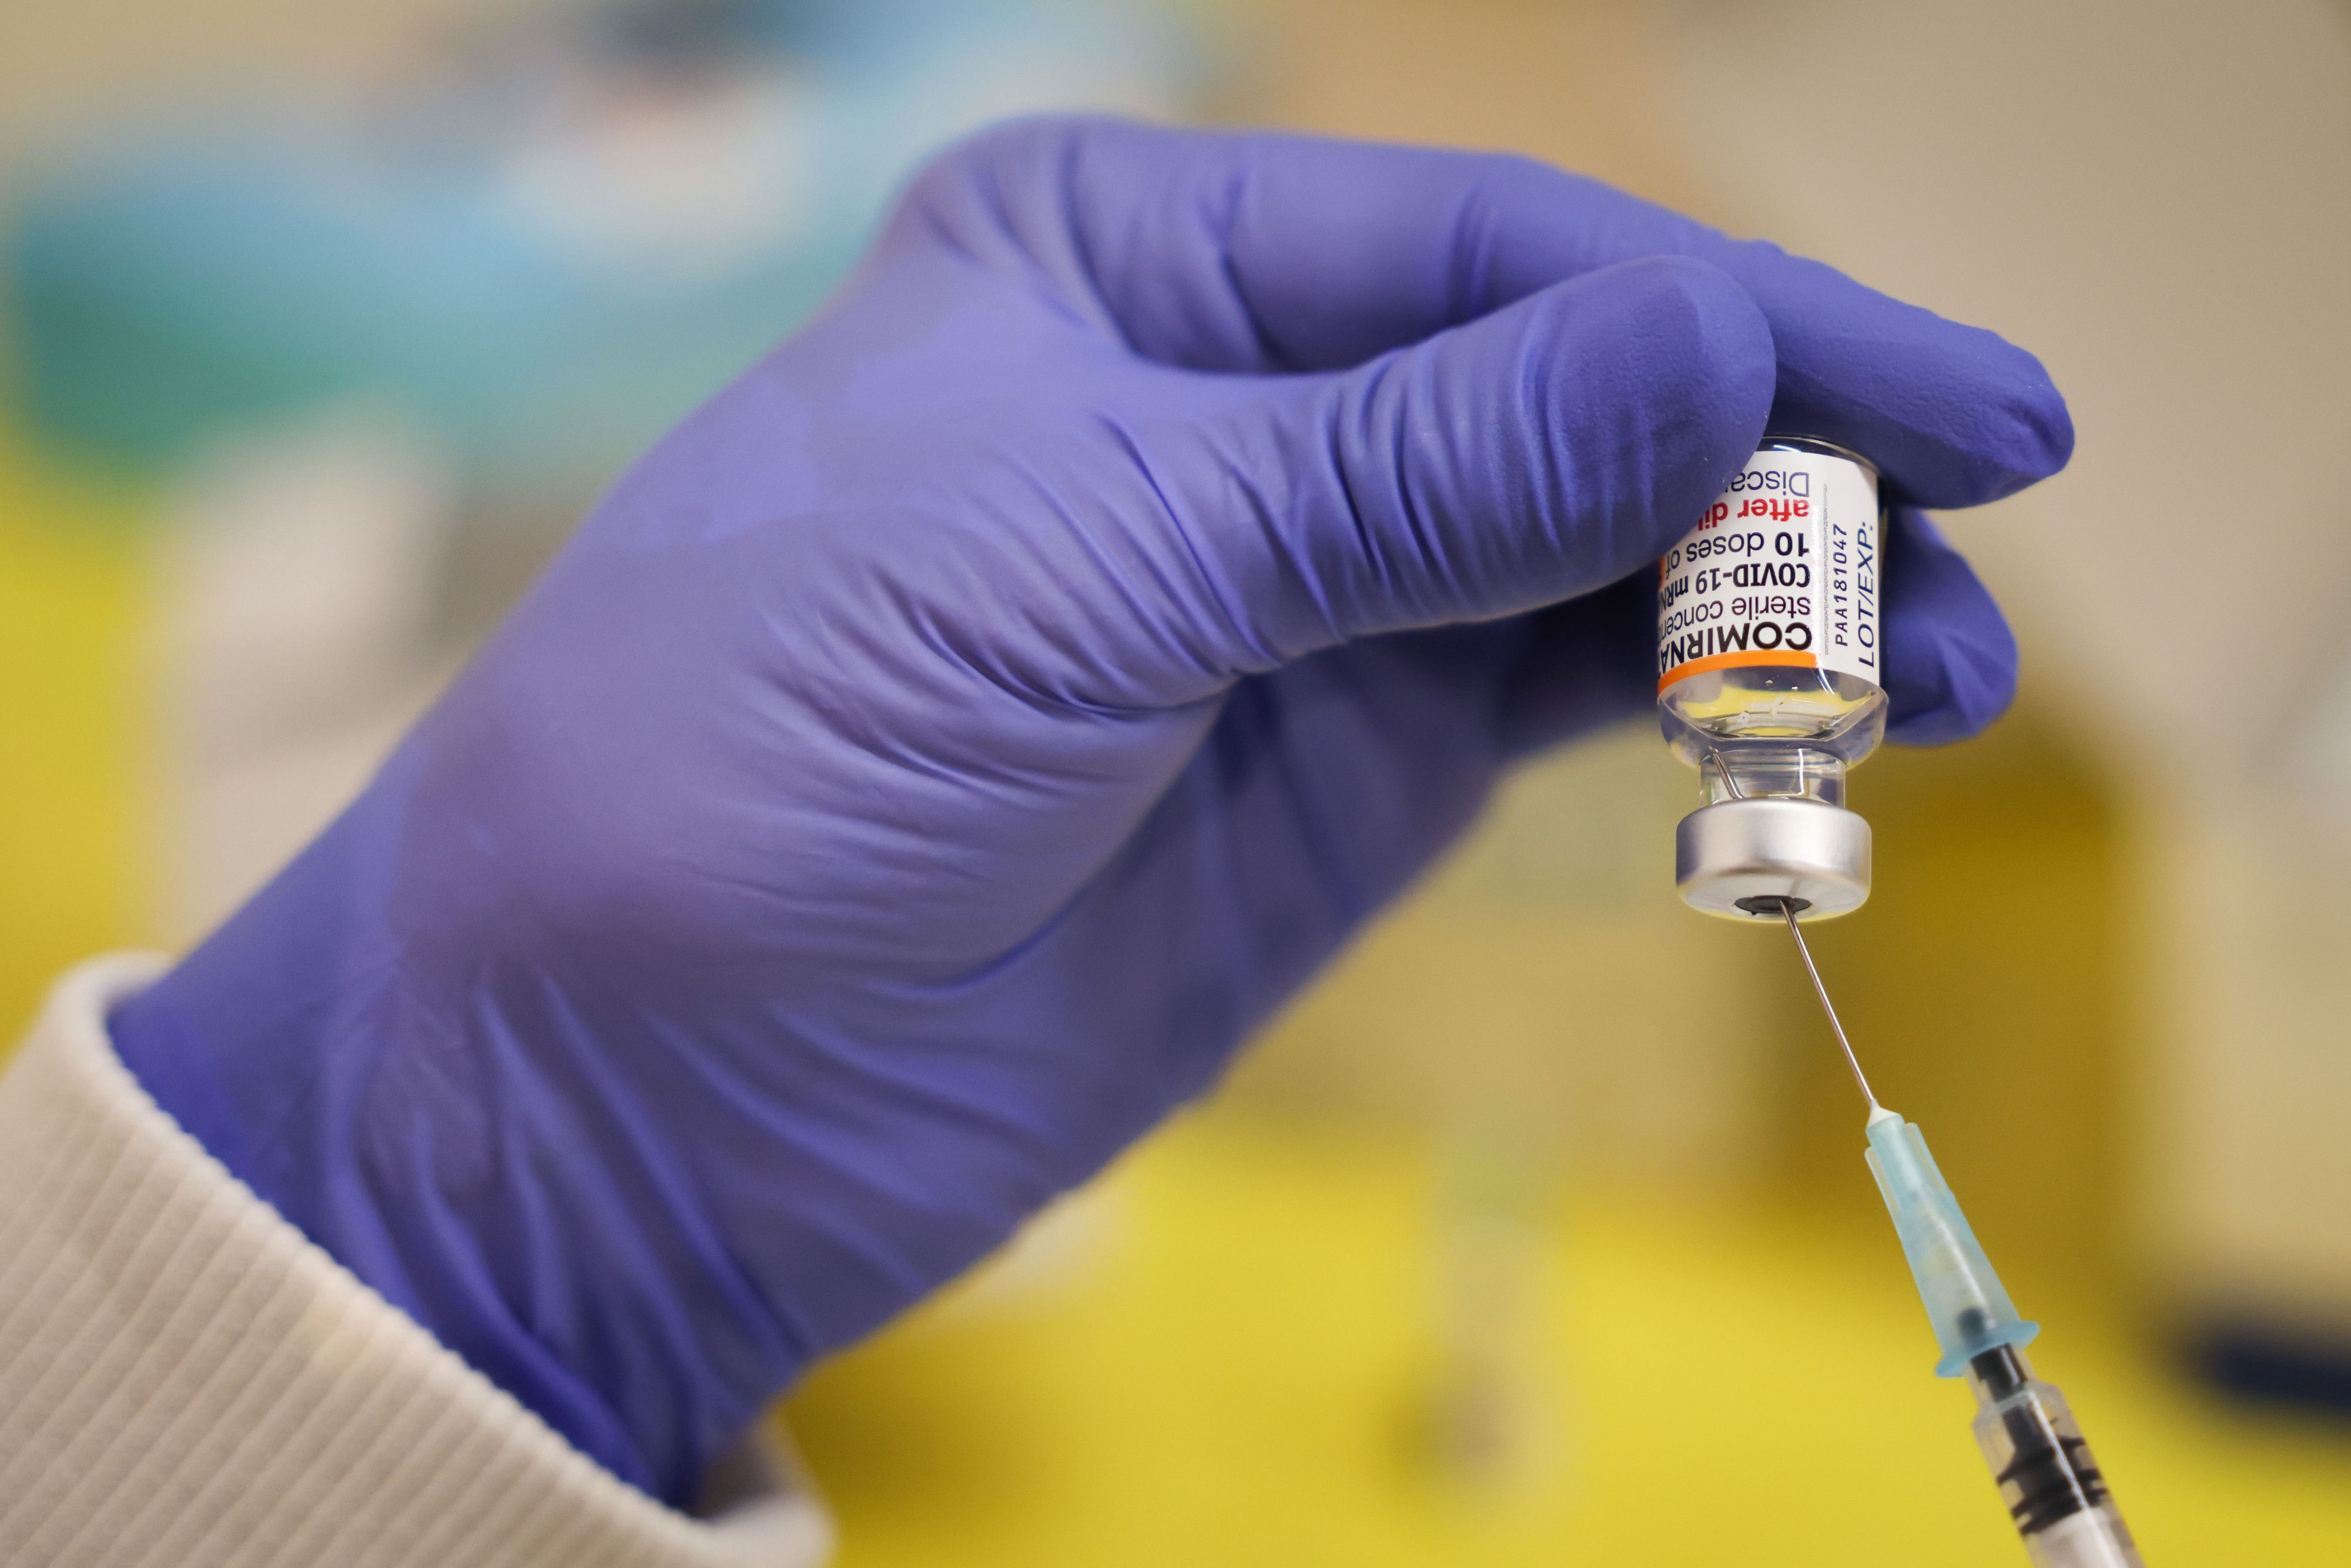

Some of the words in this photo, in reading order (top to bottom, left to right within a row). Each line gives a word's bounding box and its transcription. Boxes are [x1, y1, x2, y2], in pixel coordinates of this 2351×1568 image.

[1725, 471, 1809, 497] Disca
[1737, 498, 1809, 522] after
[1686, 532, 1764, 562] doses
[1775, 531, 1810, 557] 10
[1666, 550, 1680, 580] of
[1696, 562, 1810, 594] COVID-19
[1833, 524, 1848, 646] PAA181047
[1857, 521, 1874, 668] LOT/EXP:
[1732, 595, 1811, 620] sterile
[1659, 621, 1812, 676] COMIRNA
